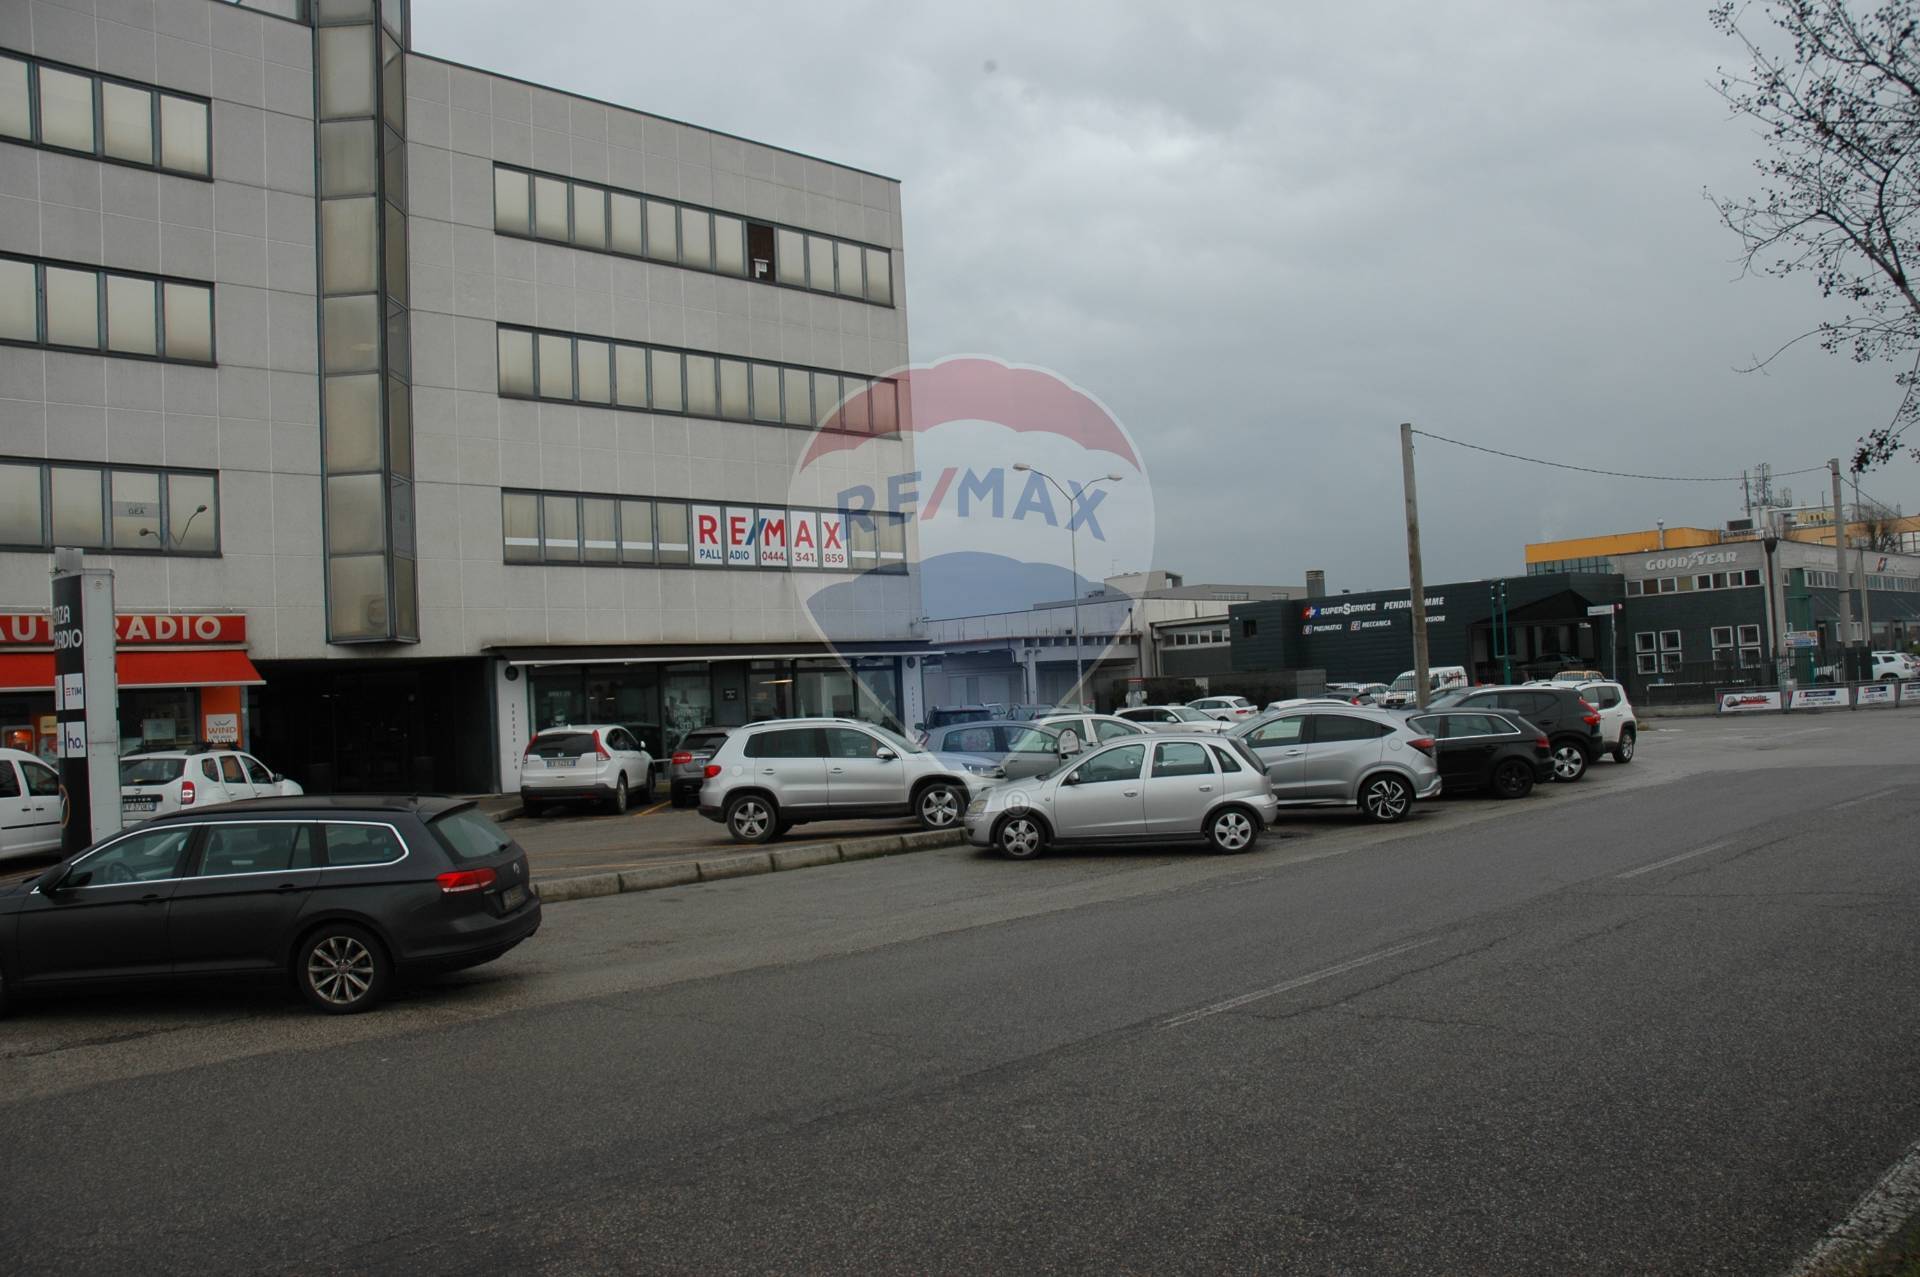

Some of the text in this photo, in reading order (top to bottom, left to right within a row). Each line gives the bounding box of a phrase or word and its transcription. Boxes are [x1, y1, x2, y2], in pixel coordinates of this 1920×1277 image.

[698, 514, 842, 549] RE/MAX
[824, 553, 844, 563] 859
[1646, 551, 1737, 571] GOODYEAR
[1424, 596, 1445, 606] MME
[1313, 624, 1342, 632] PNEUMATICI
[1361, 620, 1391, 628] MECCANICA
